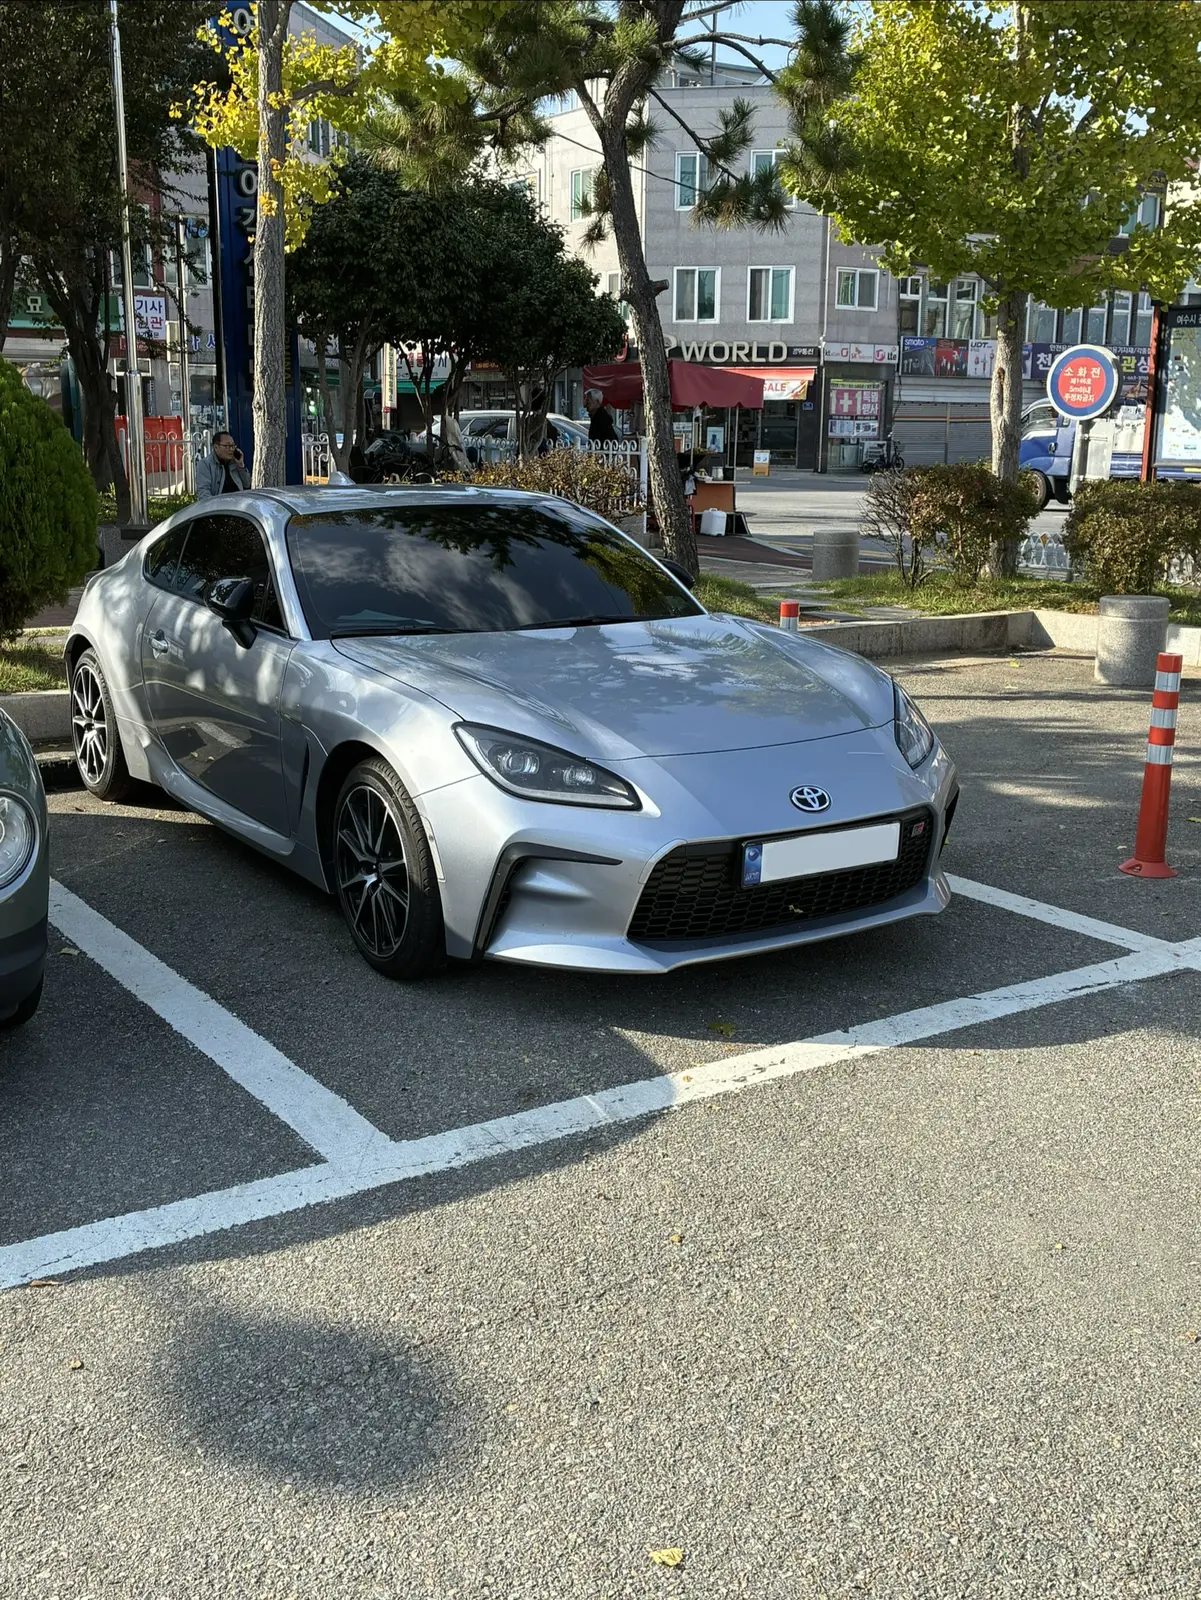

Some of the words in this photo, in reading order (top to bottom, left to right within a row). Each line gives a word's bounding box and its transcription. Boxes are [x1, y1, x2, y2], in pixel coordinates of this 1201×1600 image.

[1176, 313, 1197, 326] 여수시
[680, 340, 788, 363] WORLD
[970, 341, 989, 349] UDT
[763, 382, 787, 392] SALE
[829, 389, 862, 415] 1+1
